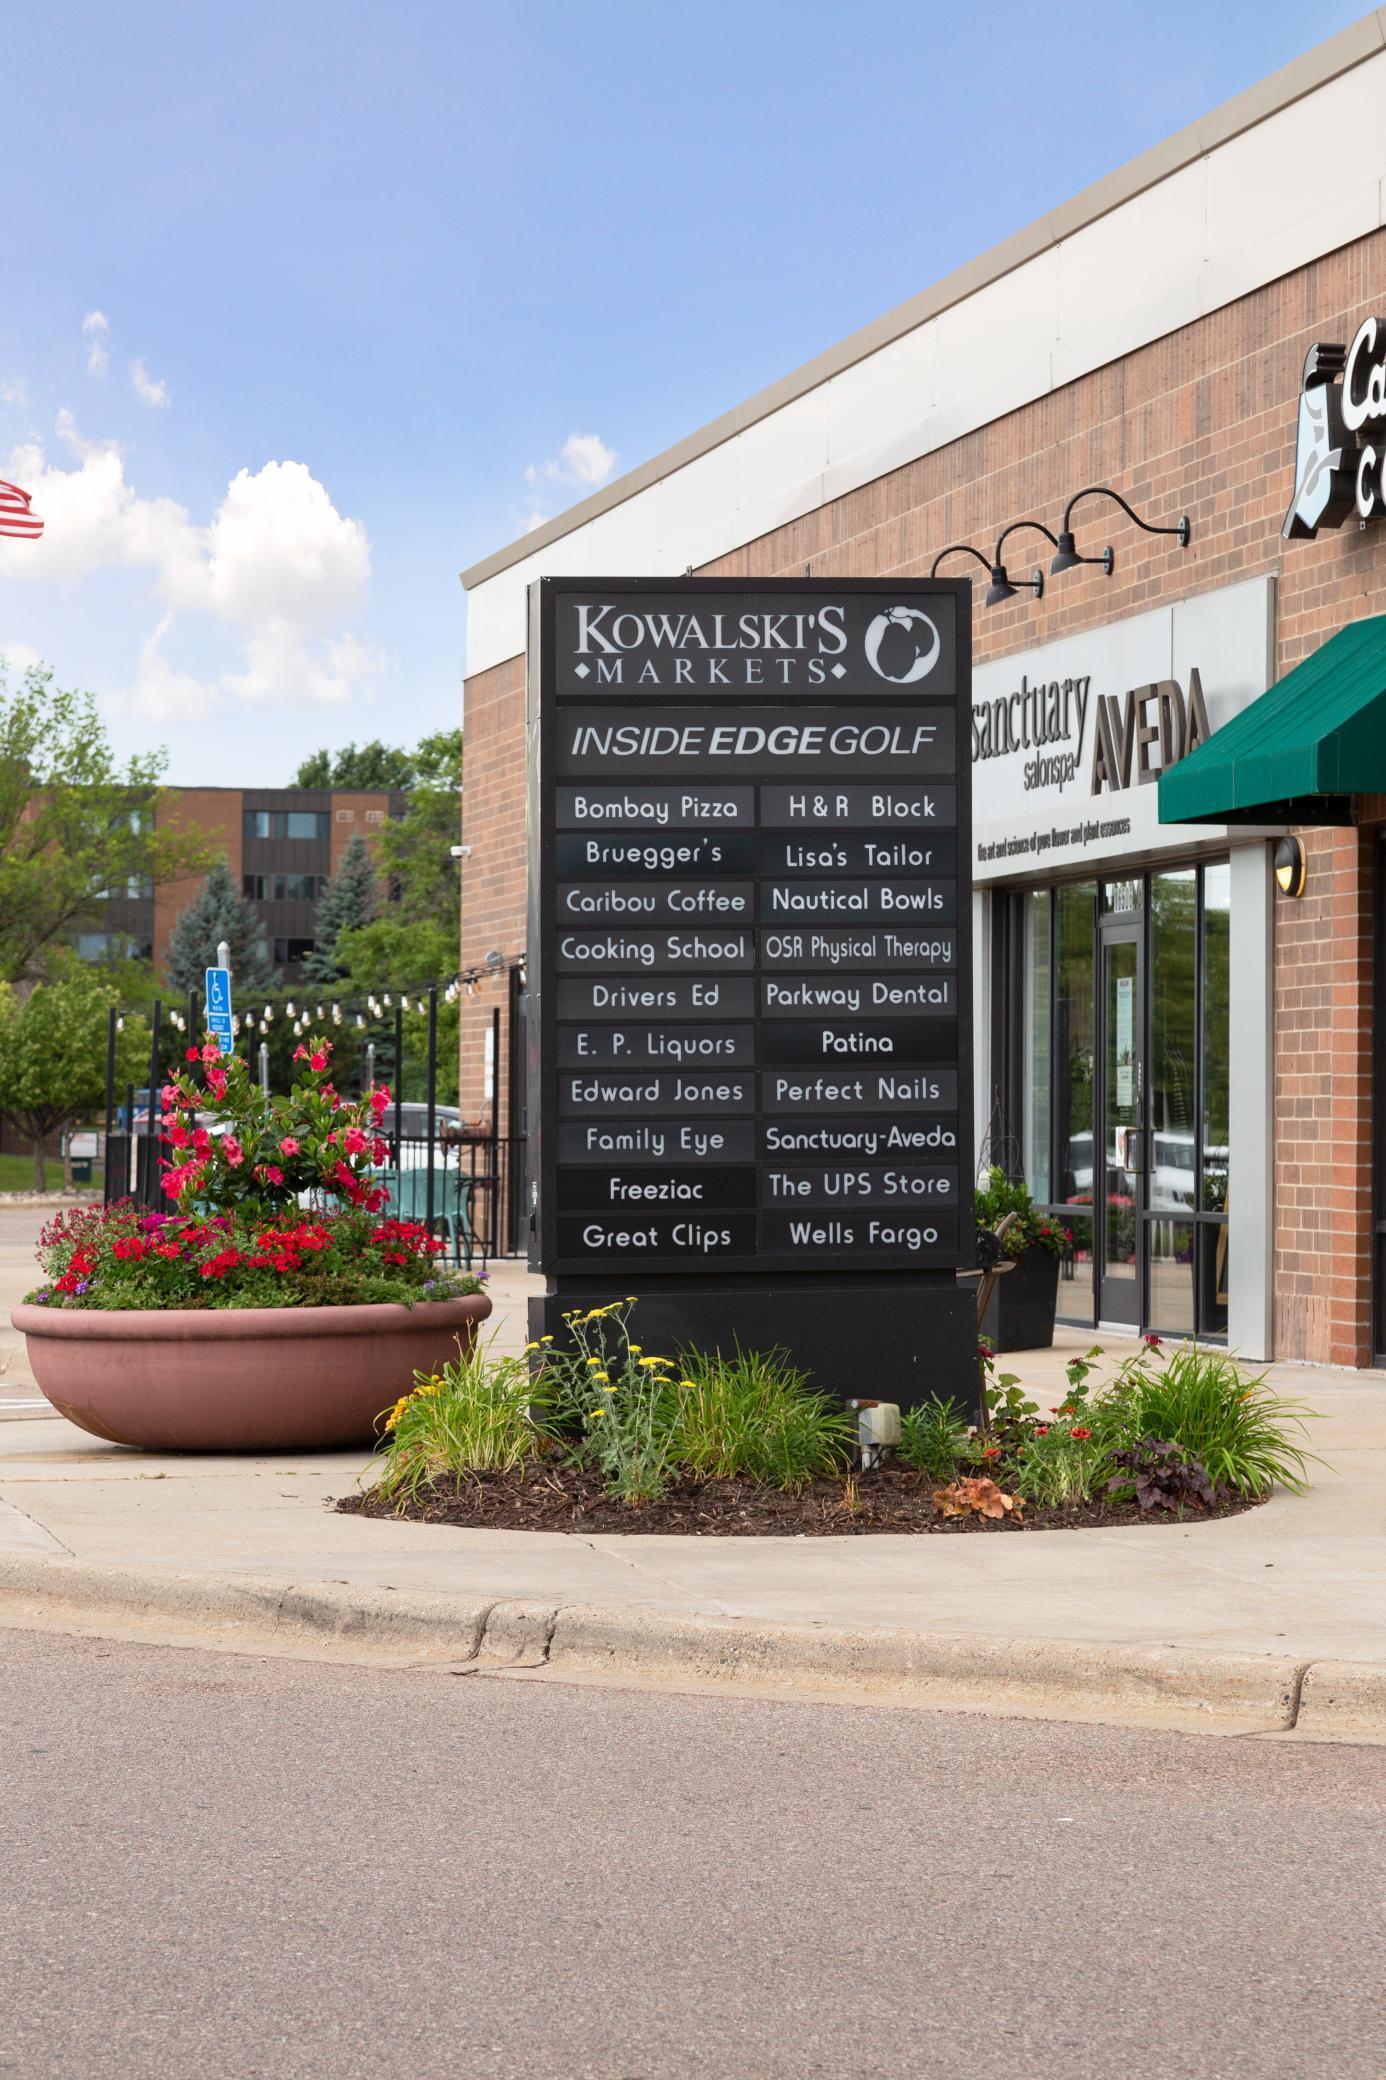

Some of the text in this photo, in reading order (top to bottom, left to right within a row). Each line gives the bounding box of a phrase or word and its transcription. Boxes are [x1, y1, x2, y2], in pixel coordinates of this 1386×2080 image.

[573, 605, 848, 655] KOWALSKI'S
[595, 658, 827, 684] MARKETS
[972, 674, 1091, 768] sanctuary
[1091, 667, 1212, 796] AVEDA
[571, 725, 938, 756] INSIDE EDGE GOLF
[1023, 750, 1075, 793] salonspa
[574, 795, 738, 825] Bombay Pizza
[871, 795, 936, 818] Block
[586, 838, 722, 870] Bruegger's
[786, 843, 933, 867] Lisa's Tailor
[566, 889, 746, 912] Caribou Coffee
[772, 887, 944, 910] Nautical Bowls
[561, 936, 745, 966] Cooking School
[765, 934, 952, 964] OSR Physical Therapy
[592, 984, 719, 1007] Drivers Ed
[766, 982, 948, 1012] Parkway Dental
[577, 1033, 735, 1062] E. P. Liquors
[822, 1031, 893, 1053] Patina
[571, 1079, 743, 1102] Edward Jones
[776, 1078, 940, 1101] Perfect Nails
[587, 1127, 724, 1157] Family Eye
[766, 1125, 956, 1155] Sanctuary-Aveda
[610, 1178, 703, 1200] Freeziac
[769, 1172, 951, 1196] The UPS Store
[583, 1223, 731, 1252] Great Clips
[789, 1221, 938, 1250] Wells Fargo
